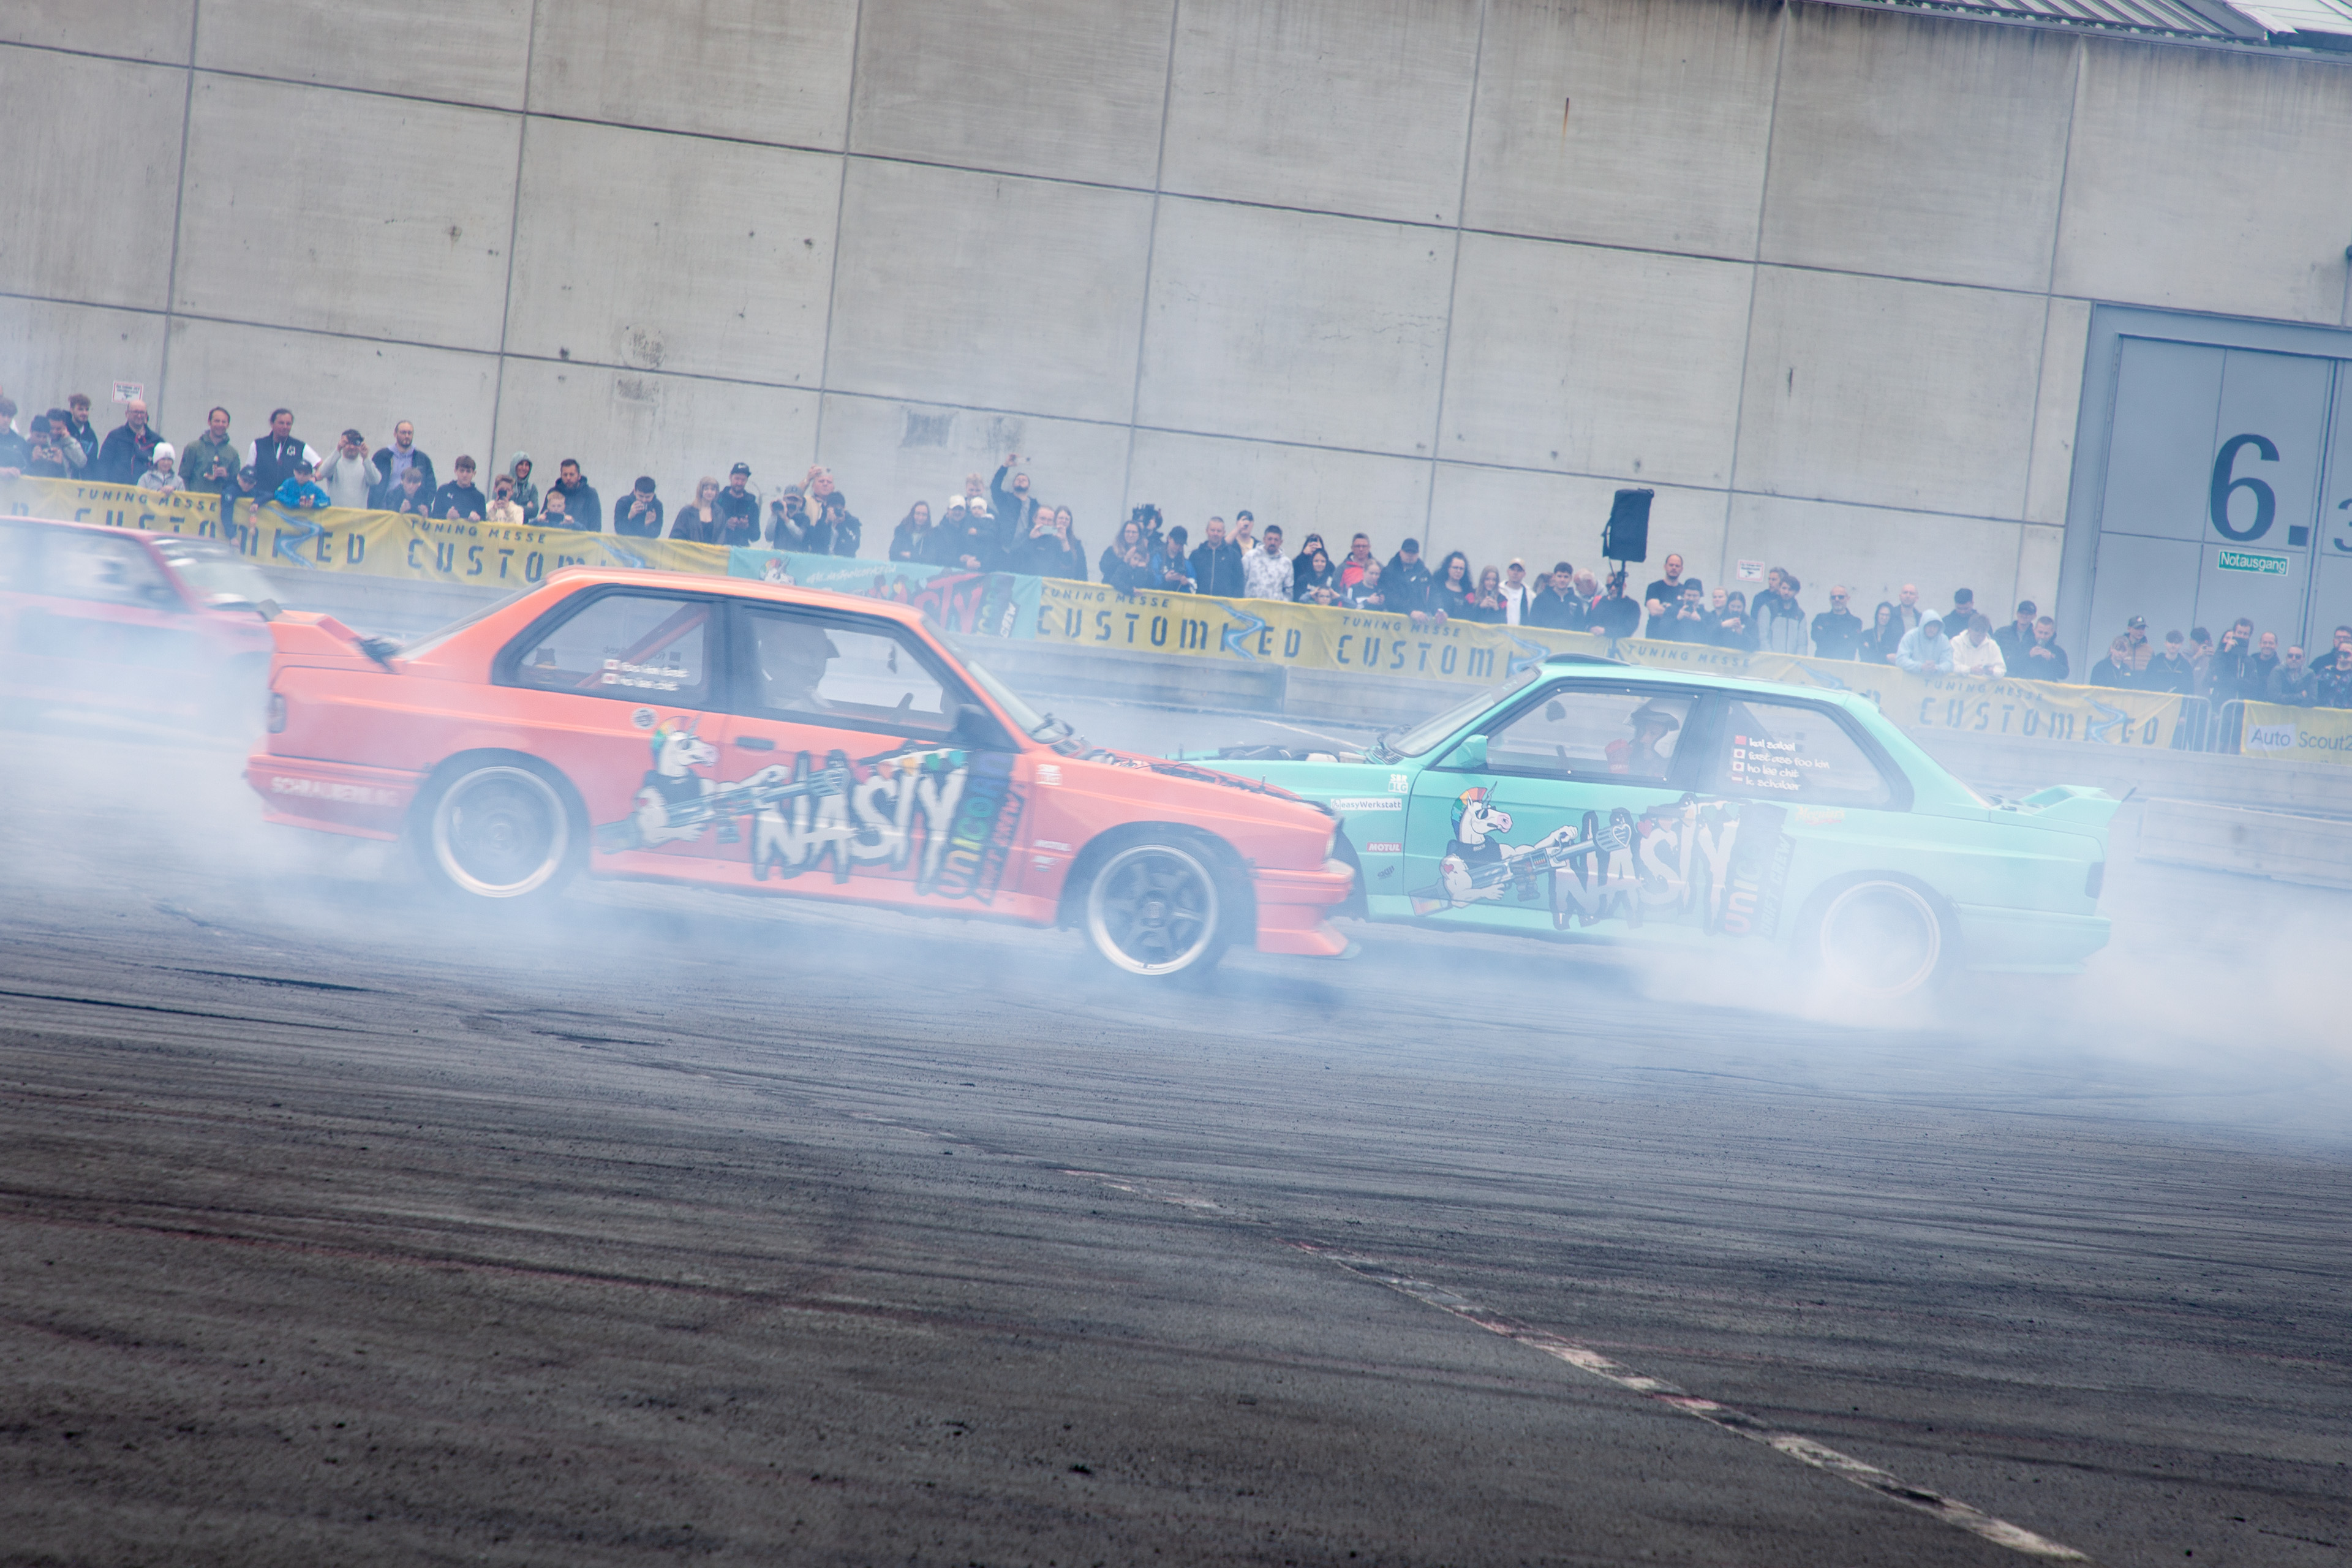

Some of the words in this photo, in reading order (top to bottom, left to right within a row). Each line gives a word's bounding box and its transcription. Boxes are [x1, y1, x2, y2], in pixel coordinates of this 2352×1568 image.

[77, 488, 148, 505] TUNING
[159, 497, 217, 512] MESSE
[410, 519, 478, 537] TUNING
[489, 528, 546, 544] MESSE
[2221, 551, 2286, 574] Notausgang
[1041, 586, 1106, 602] TUNING
[1115, 594, 1169, 608] MESSE
[1343, 616, 1402, 632] TUNING
[1411, 624, 1461, 638] MESSE
[1629, 644, 1689, 662] TUNING
[1698, 653, 1751, 668] MESSE
[1924, 679, 1986, 693] TUNING
[2250, 728, 2291, 747] Auto
[1747, 763, 1761, 774] ho
[1341, 801, 1401, 810] easyWerkstatt
[1368, 843, 1400, 851] MOTUL
